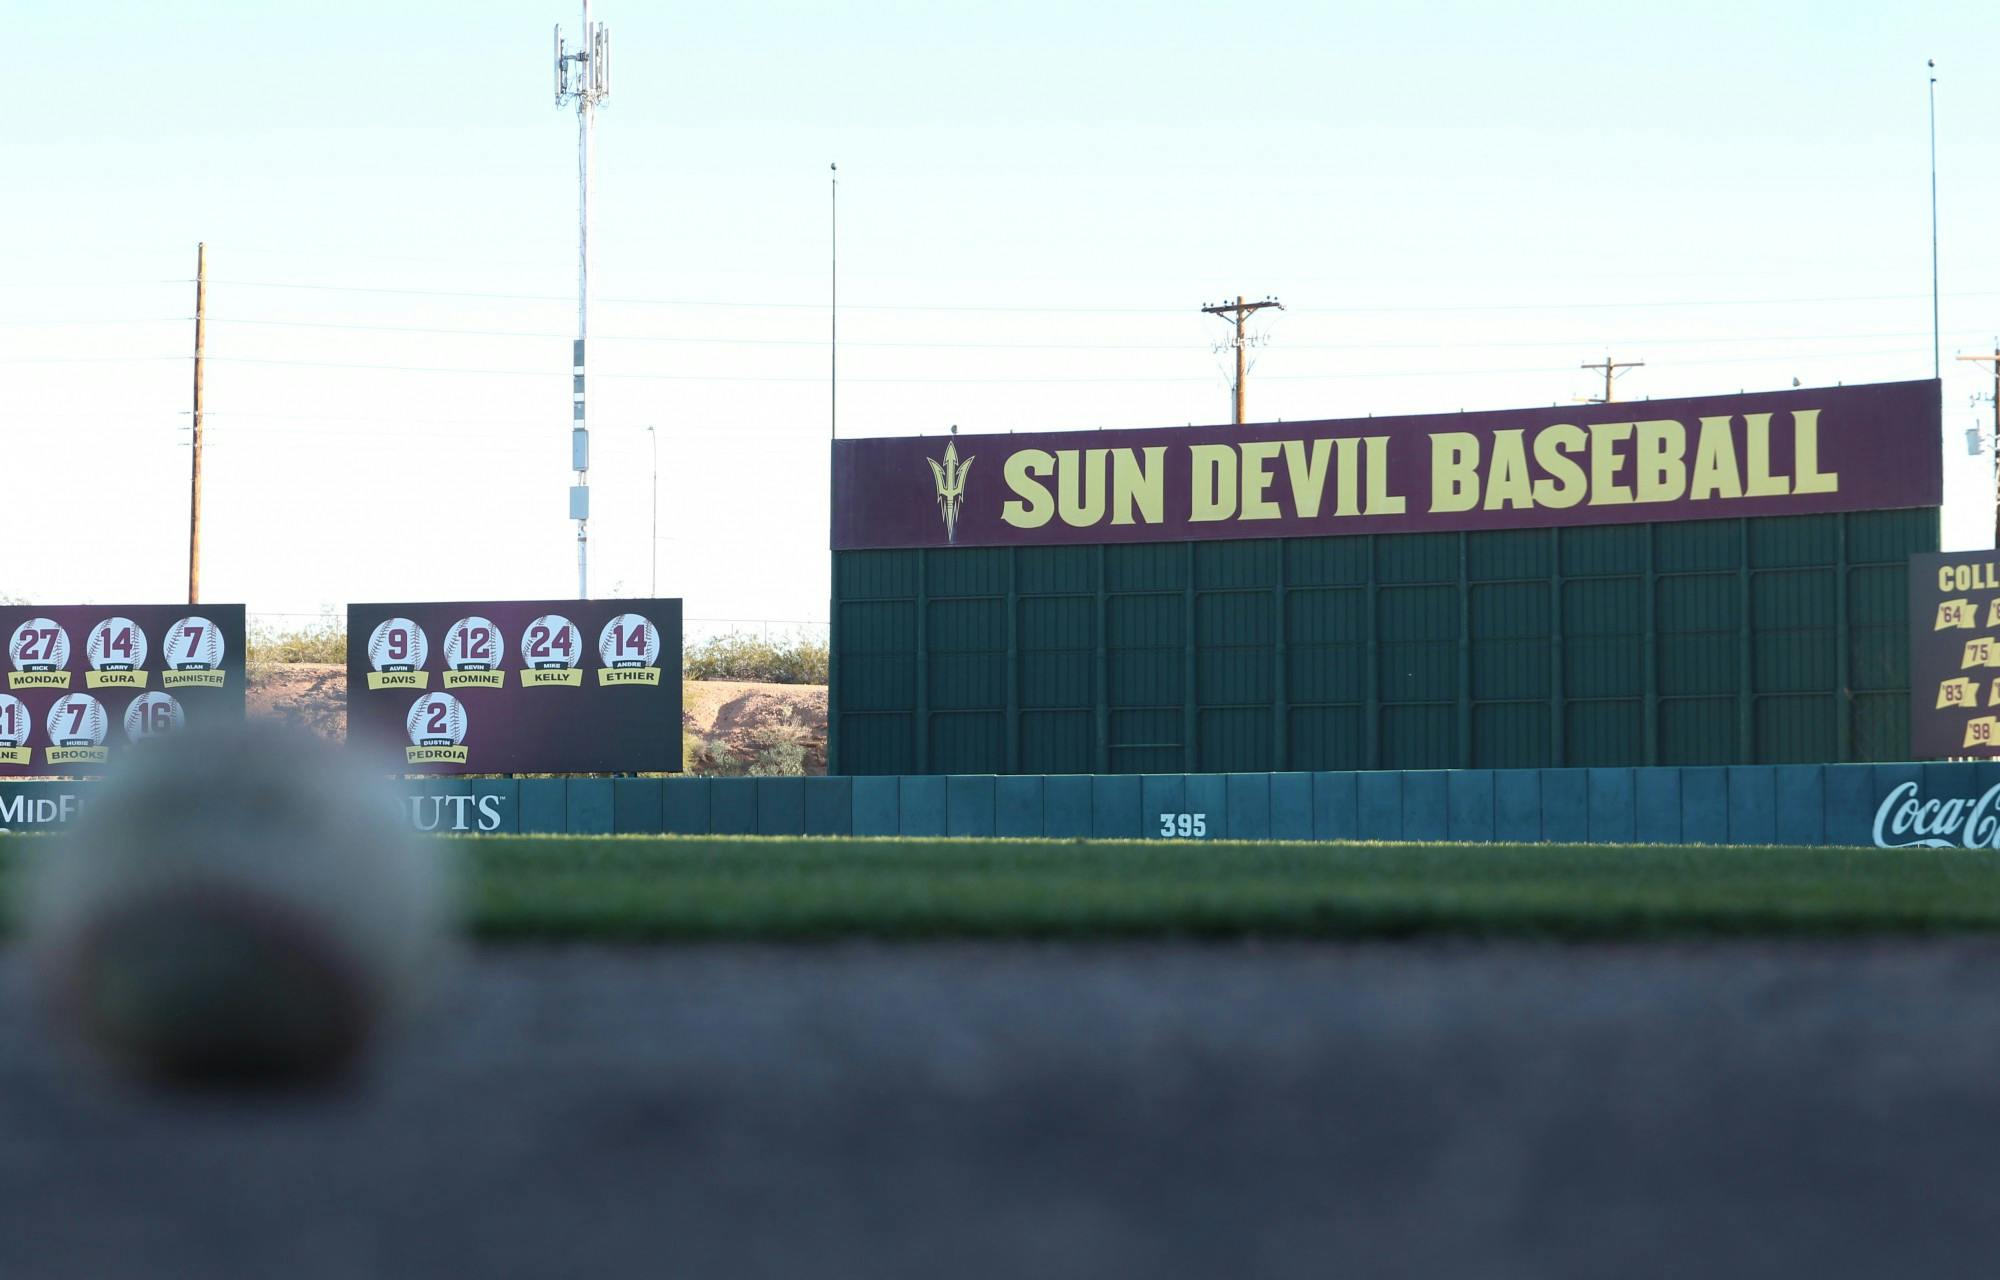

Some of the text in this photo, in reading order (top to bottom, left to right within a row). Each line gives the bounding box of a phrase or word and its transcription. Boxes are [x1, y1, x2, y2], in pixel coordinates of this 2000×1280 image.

[1000, 409, 1838, 529] SUN DEVIL BASEBALL
[1938, 562, 2000, 592] COLL
[19, 629, 60, 660] 27
[100, 627, 133, 659] 14
[183, 626, 204, 658] 7
[388, 628, 408, 660] 9
[458, 627, 490, 659] 12
[530, 625, 572, 657] 24
[613, 624, 647, 657] 14
[14, 675, 67, 685] MONDAY
[100, 674, 135, 684] GURA
[164, 674, 223, 685] BANNISTER
[381, 675, 416, 685] DAVIS
[450, 674, 499, 685] ROMINE
[534, 672, 570, 682] KELLY
[606, 671, 655, 682] ETHIER
[0, 704, 15, 735] 1
[67, 704, 87, 734] 7
[138, 702, 171, 733] 16
[427, 702, 447, 734] 2
[0, 751, 18, 760] NE
[51, 750, 105, 760] BROOKS
[408, 749, 465, 760] PEDROIA
[1160, 813, 1206, 837] 395
[1872, 781, 2000, 849] Coca-C
